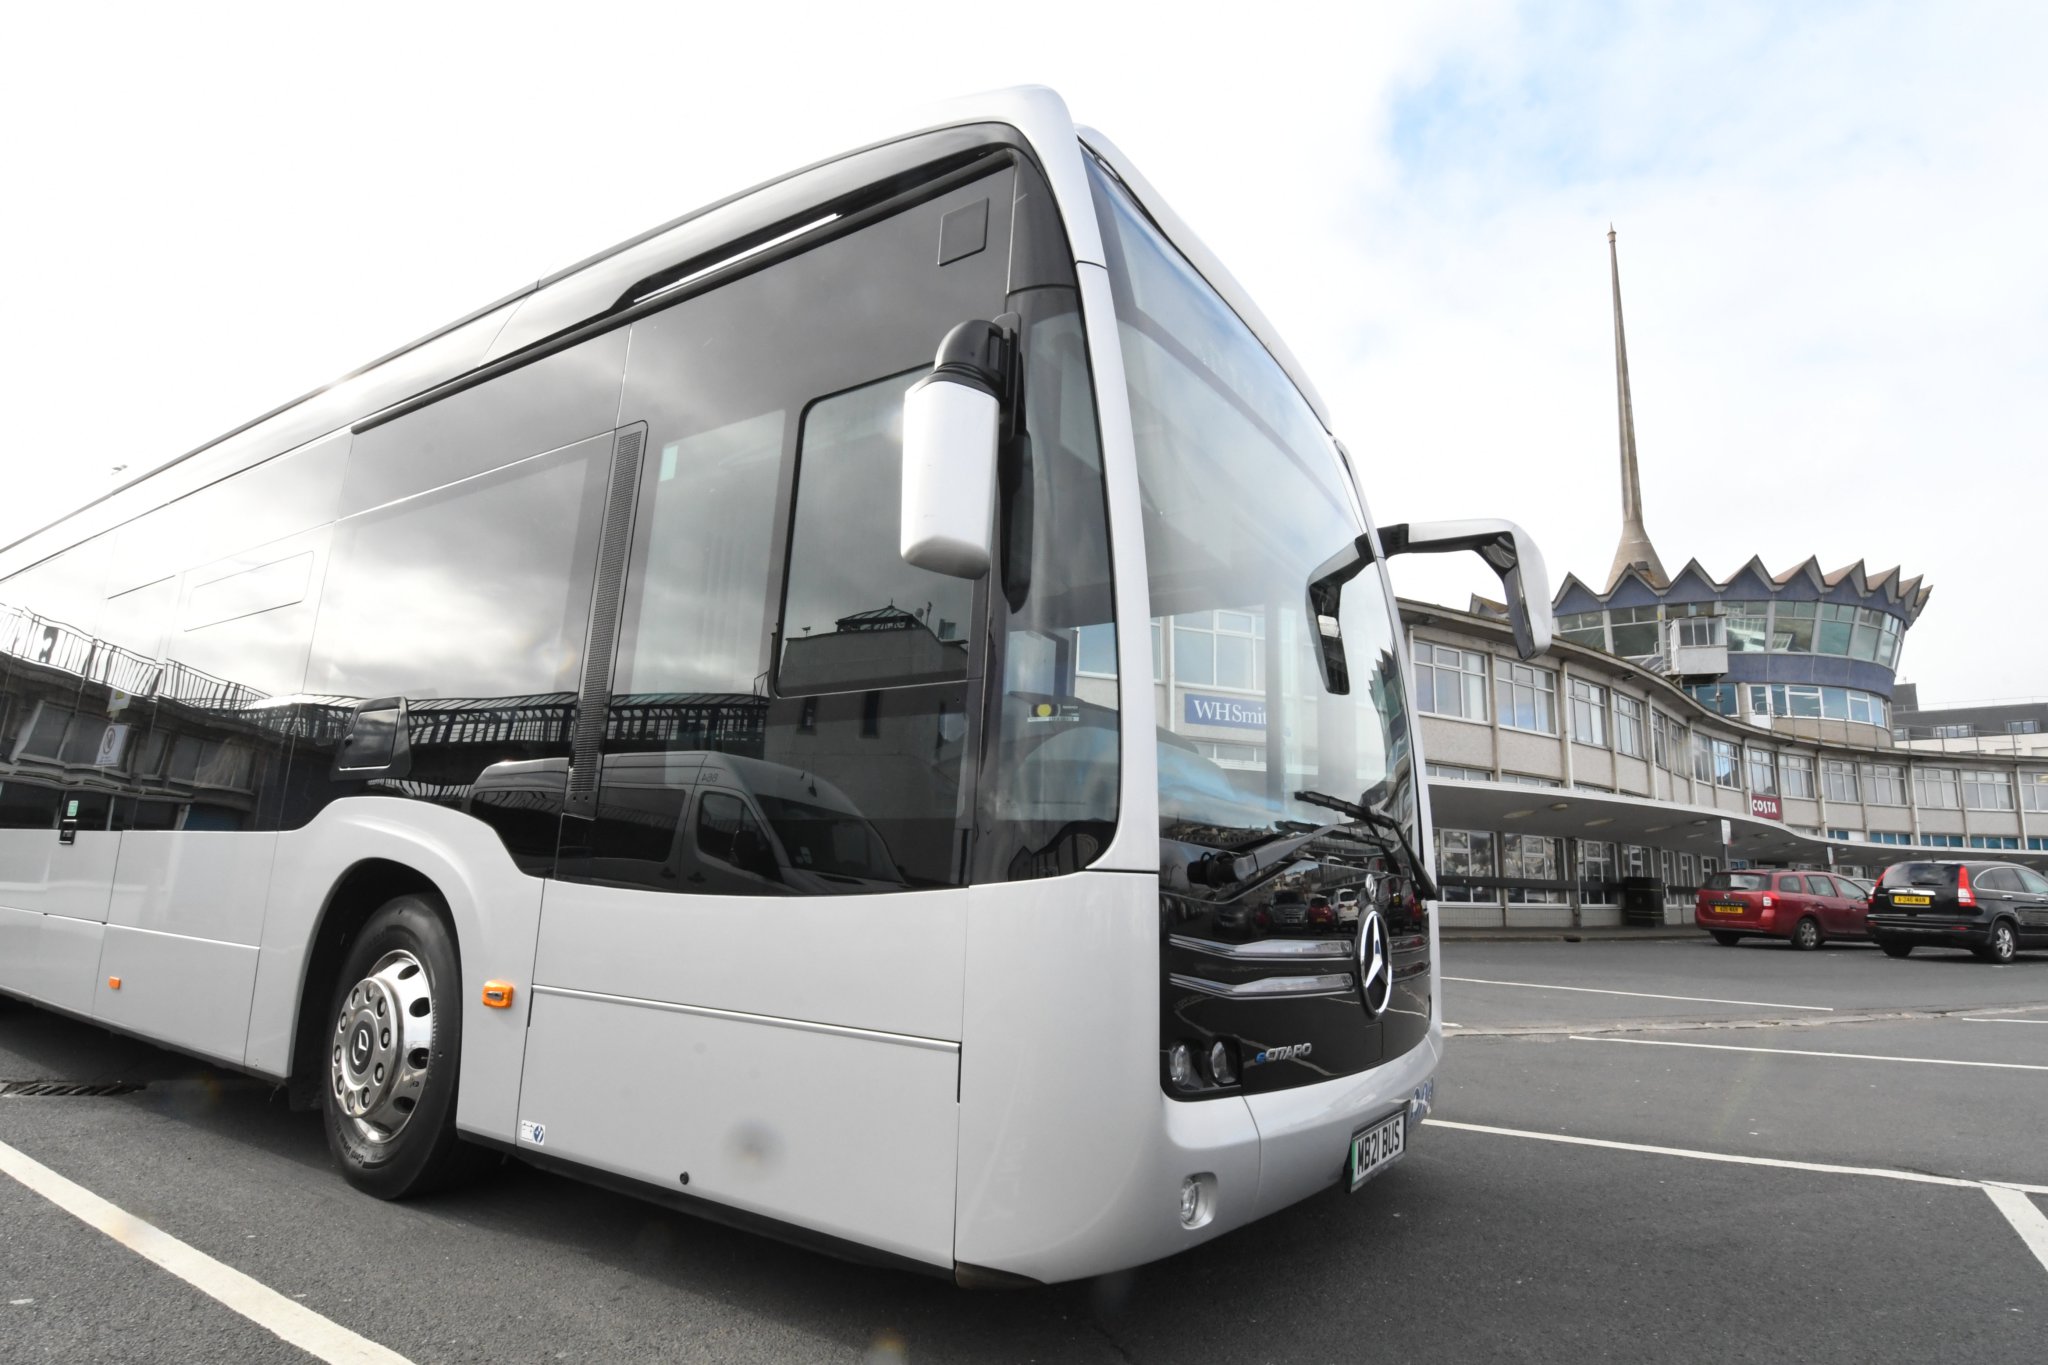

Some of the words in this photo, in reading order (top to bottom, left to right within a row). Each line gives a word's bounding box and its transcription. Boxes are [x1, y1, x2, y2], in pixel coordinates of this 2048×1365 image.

[1193, 699, 1267, 725] WHSmit
[1752, 799, 1777, 814] COSTA
[1255, 1042, 1312, 1065] eCITARO
[1357, 1130, 1380, 1175] MB21
[1381, 1119, 1400, 1160] BUS
